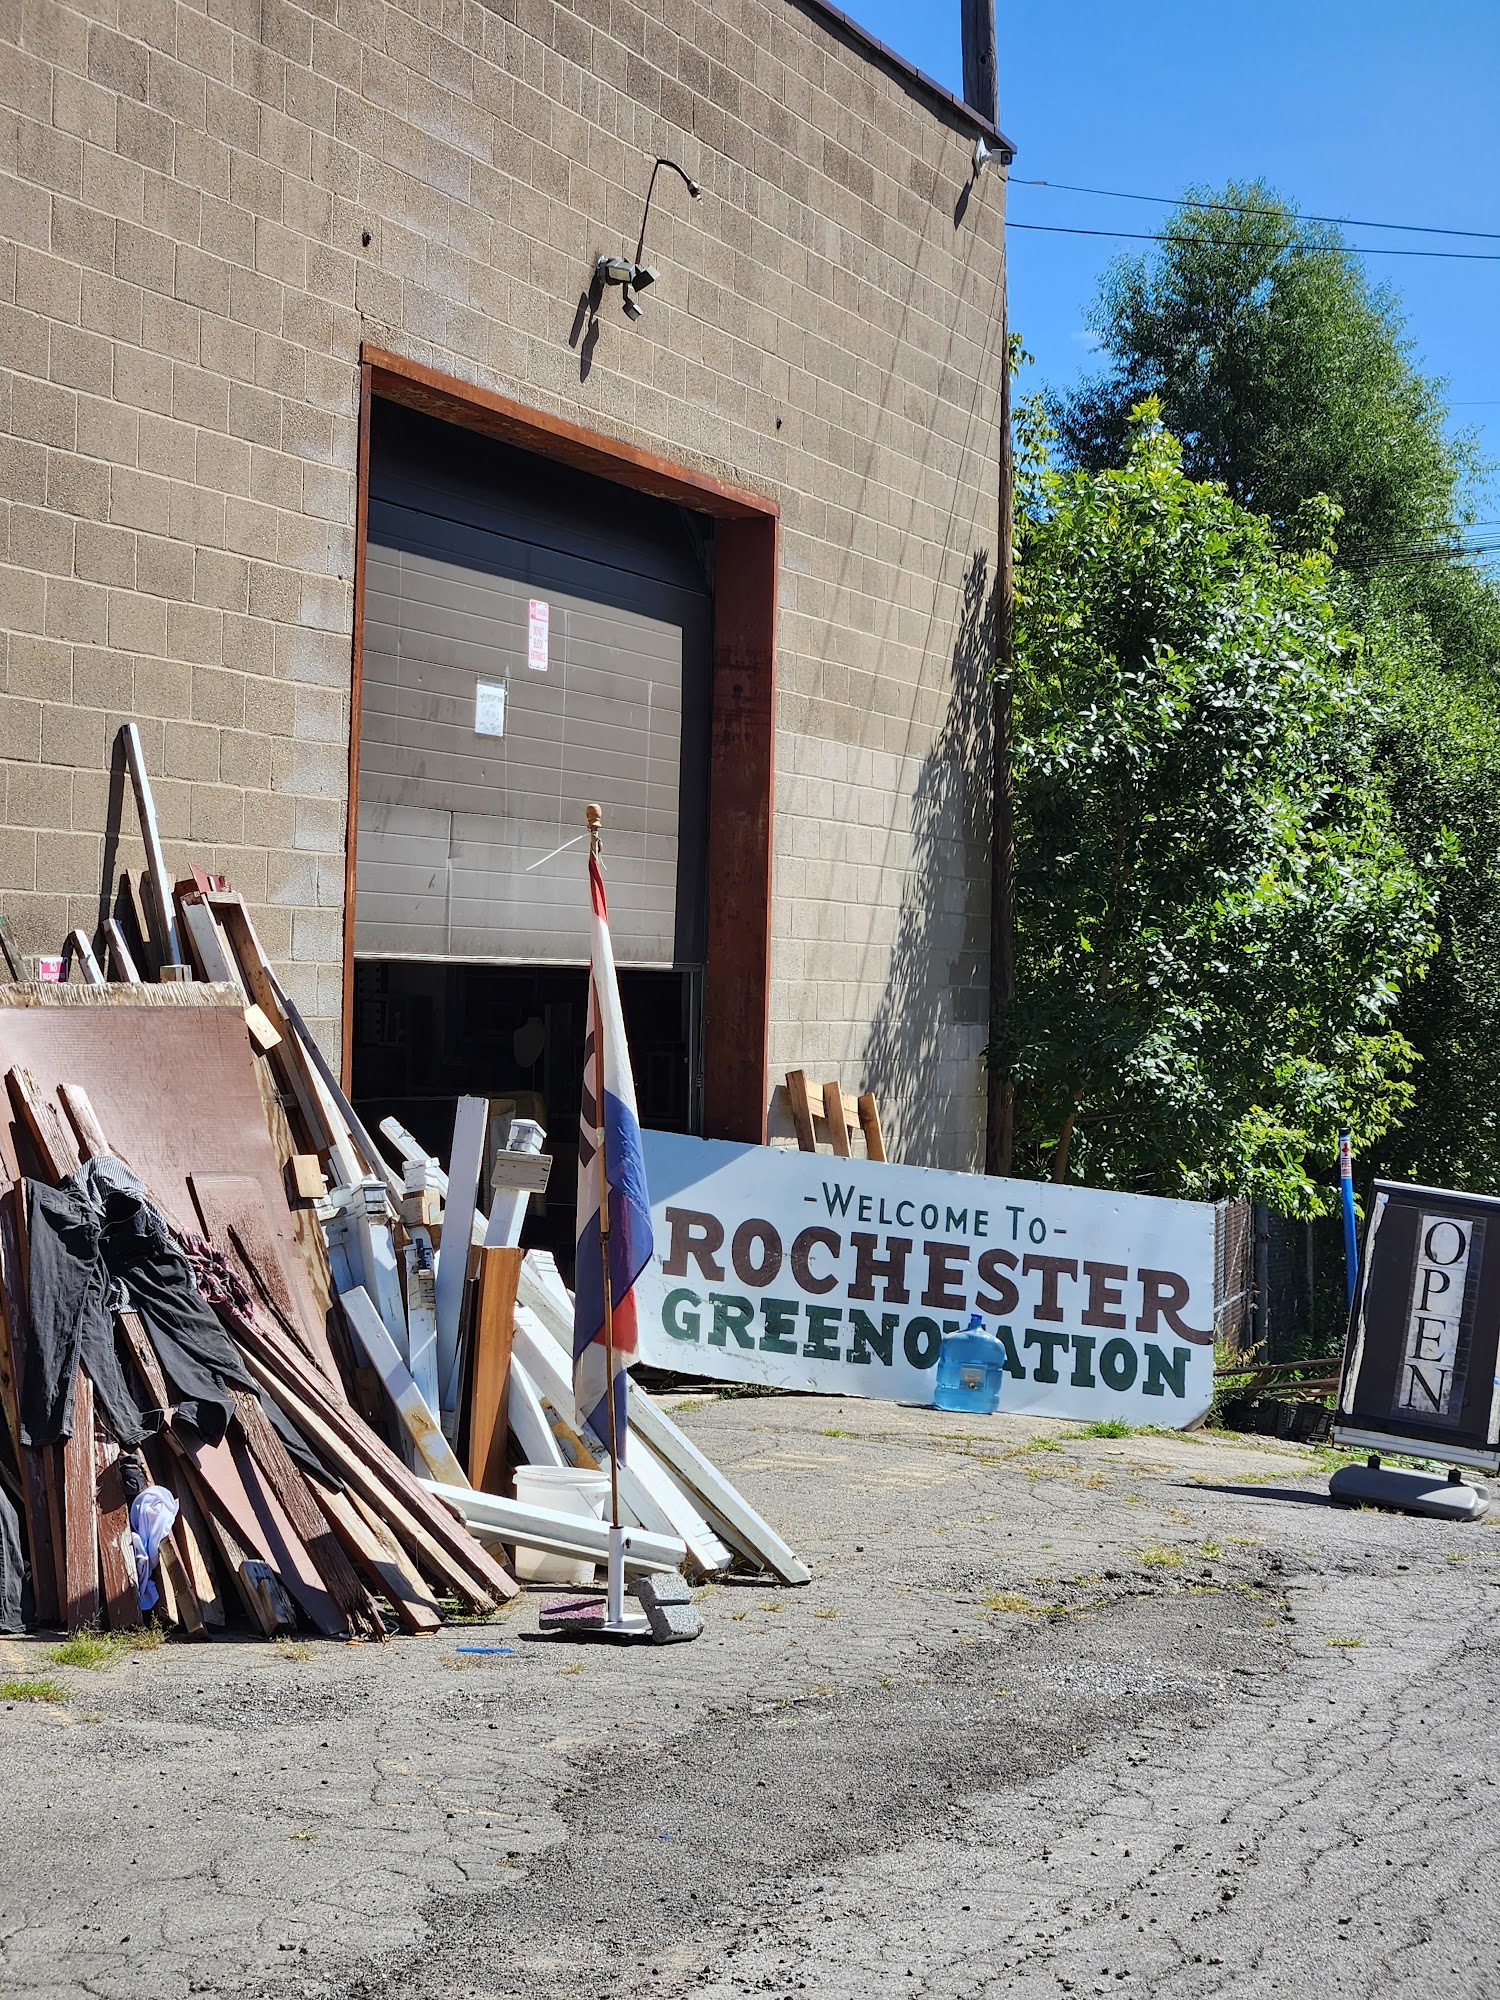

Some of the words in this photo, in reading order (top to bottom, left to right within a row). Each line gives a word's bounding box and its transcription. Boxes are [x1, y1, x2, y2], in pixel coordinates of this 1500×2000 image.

[531, 650, 546, 663] ENTRANCE
[49, 962, 58, 972] NO
[662, 1206, 1214, 1346] ROCHESTER
[1402, 1221, 1466, 1413] OPEN
[661, 1287, 1191, 1399] GREENOATION
